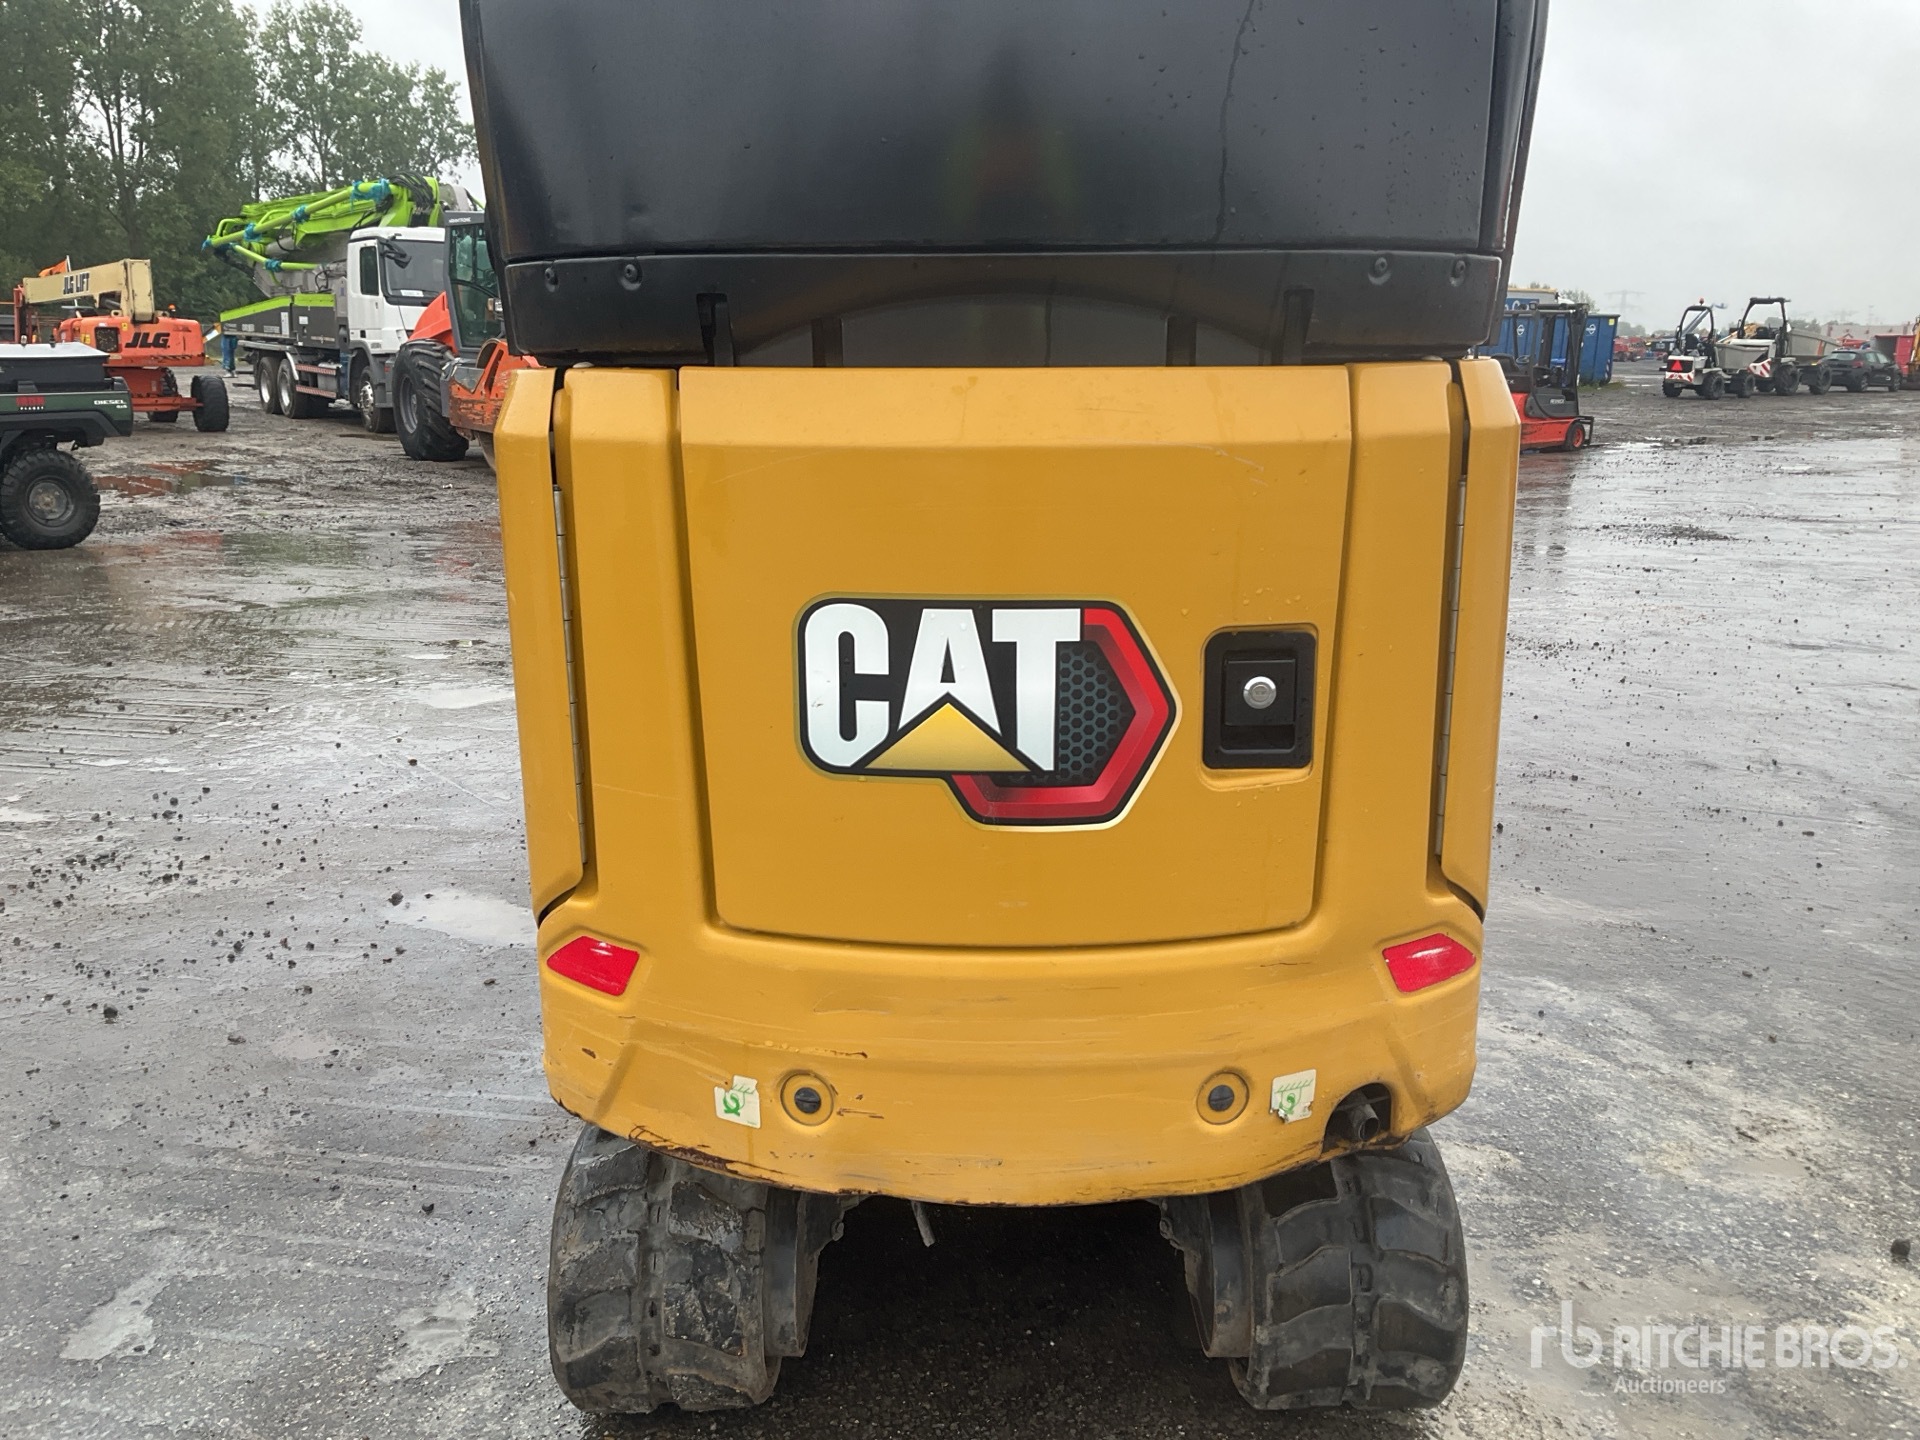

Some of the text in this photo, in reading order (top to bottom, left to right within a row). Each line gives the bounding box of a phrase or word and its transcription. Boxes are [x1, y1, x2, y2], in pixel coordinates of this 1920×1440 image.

[63, 272, 90, 295] JLG LIFT
[124, 332, 171, 349] JLG
[804, 603, 1081, 772] CAT
